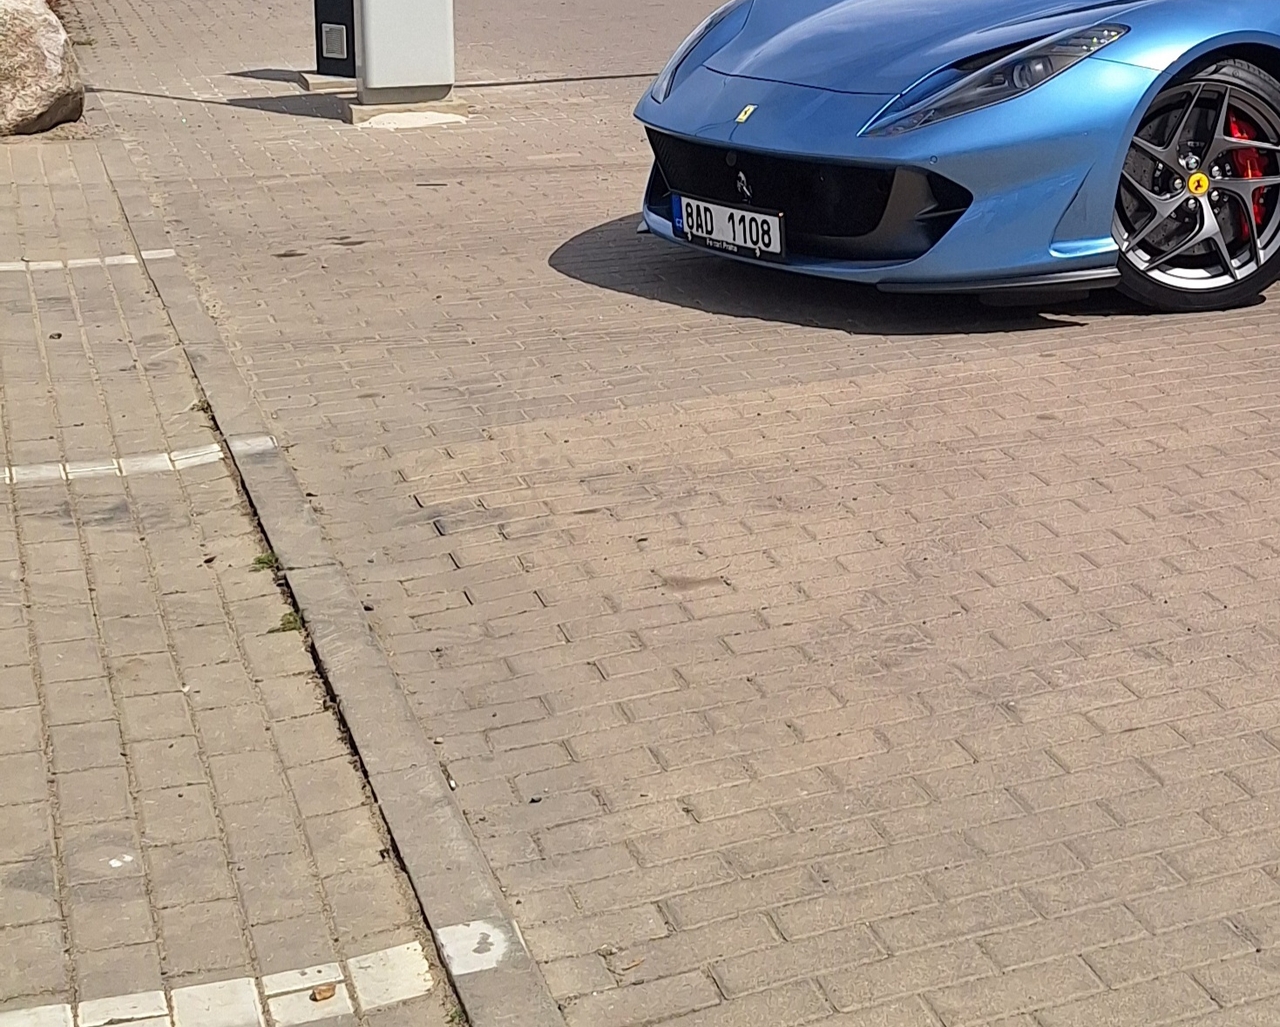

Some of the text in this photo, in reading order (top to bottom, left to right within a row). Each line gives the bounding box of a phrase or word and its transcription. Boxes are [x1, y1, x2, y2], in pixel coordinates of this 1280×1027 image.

[676, 218, 683, 228] CZ
[685, 202, 772, 249] 8AD 1108
